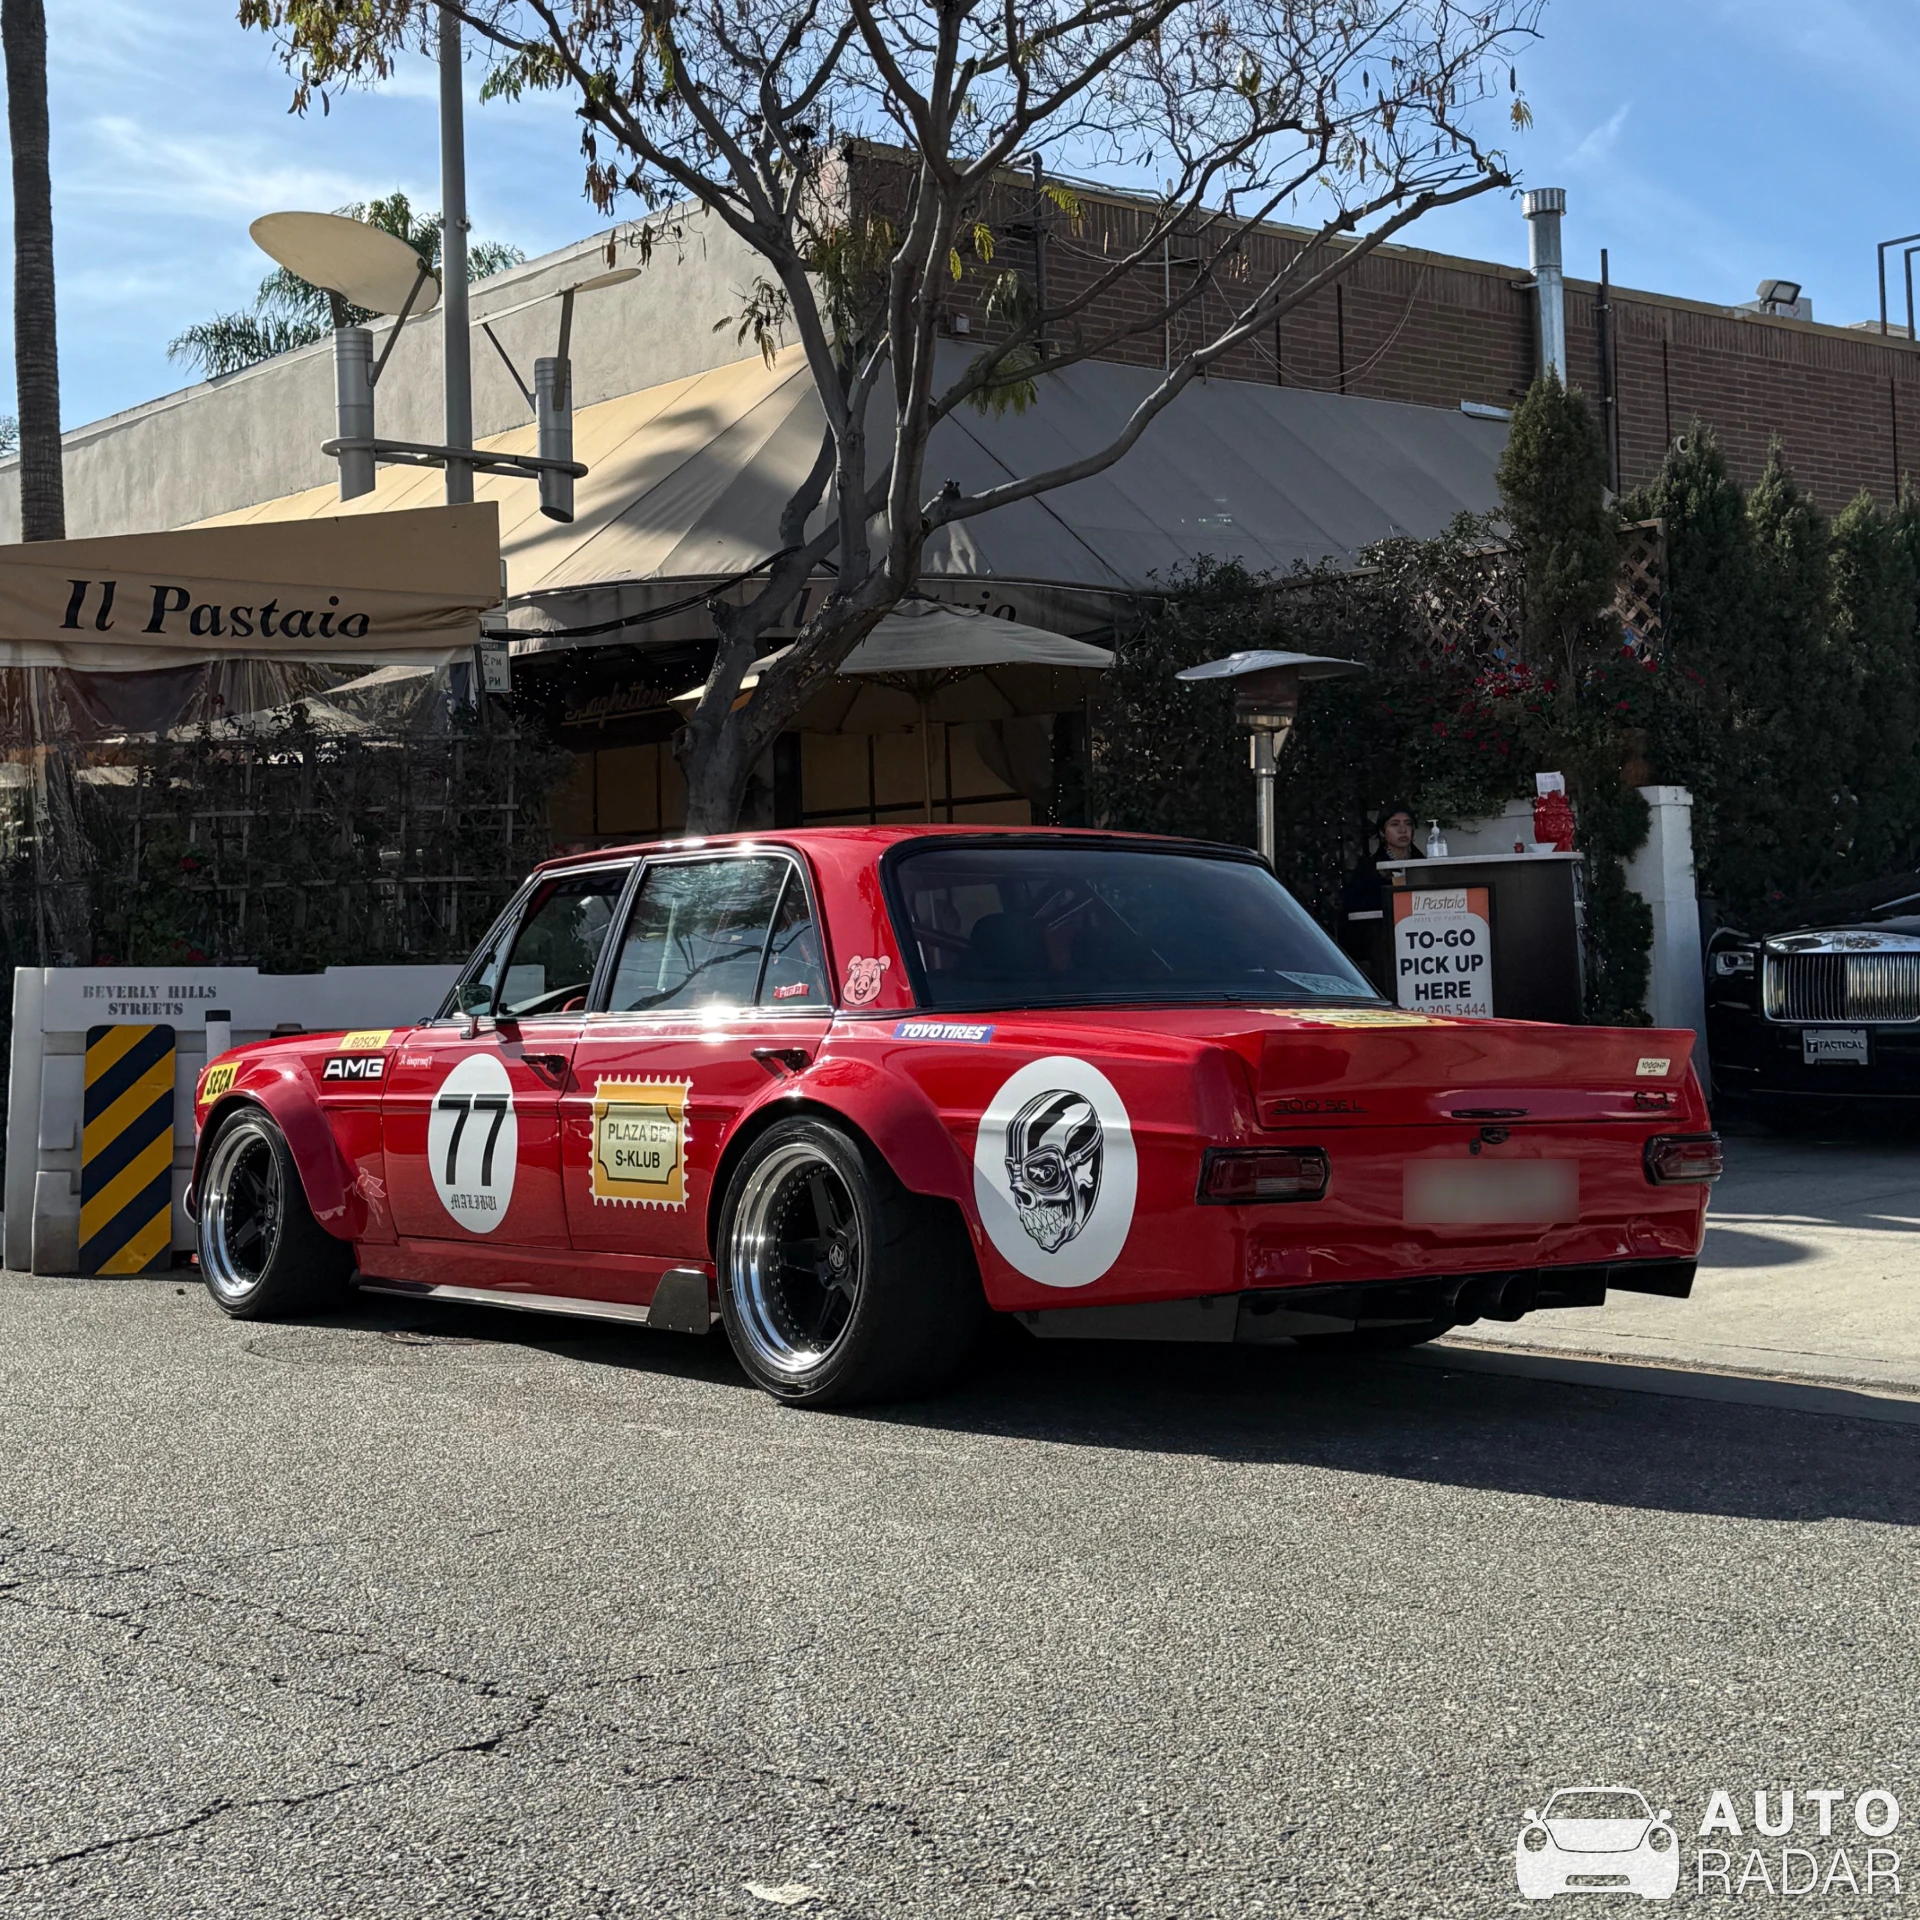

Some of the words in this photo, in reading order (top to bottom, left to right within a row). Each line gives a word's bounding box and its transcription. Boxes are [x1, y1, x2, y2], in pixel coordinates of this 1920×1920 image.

[59, 579, 117, 631] Il
[141, 584, 370, 638] Pastaio
[1422, 894, 1466, 910] Pastaio
[1405, 929, 1476, 949] TO-GO
[1400, 956, 1450, 976] PICK
[1455, 954, 1484, 972] UP
[83, 985, 160, 999] BEVERLY
[168, 985, 217, 999] HILLS
[1415, 981, 1471, 1001] HERE
[108, 1002, 184, 1015] STREETS
[1456, 1003, 1487, 1015] 5444
[901, 1023, 943, 1038] TOYO
[942, 1025, 987, 1040] TIRES
[351, 1036, 382, 1048] BOSCH
[1818, 1041, 1864, 1049] TACTICAL
[323, 1058, 385, 1078] AMG
[206, 1067, 234, 1096] SECA
[438, 1094, 510, 1186] 77
[608, 1123, 647, 1141] PLAZA
[615, 1149, 660, 1168] S-KLUB
